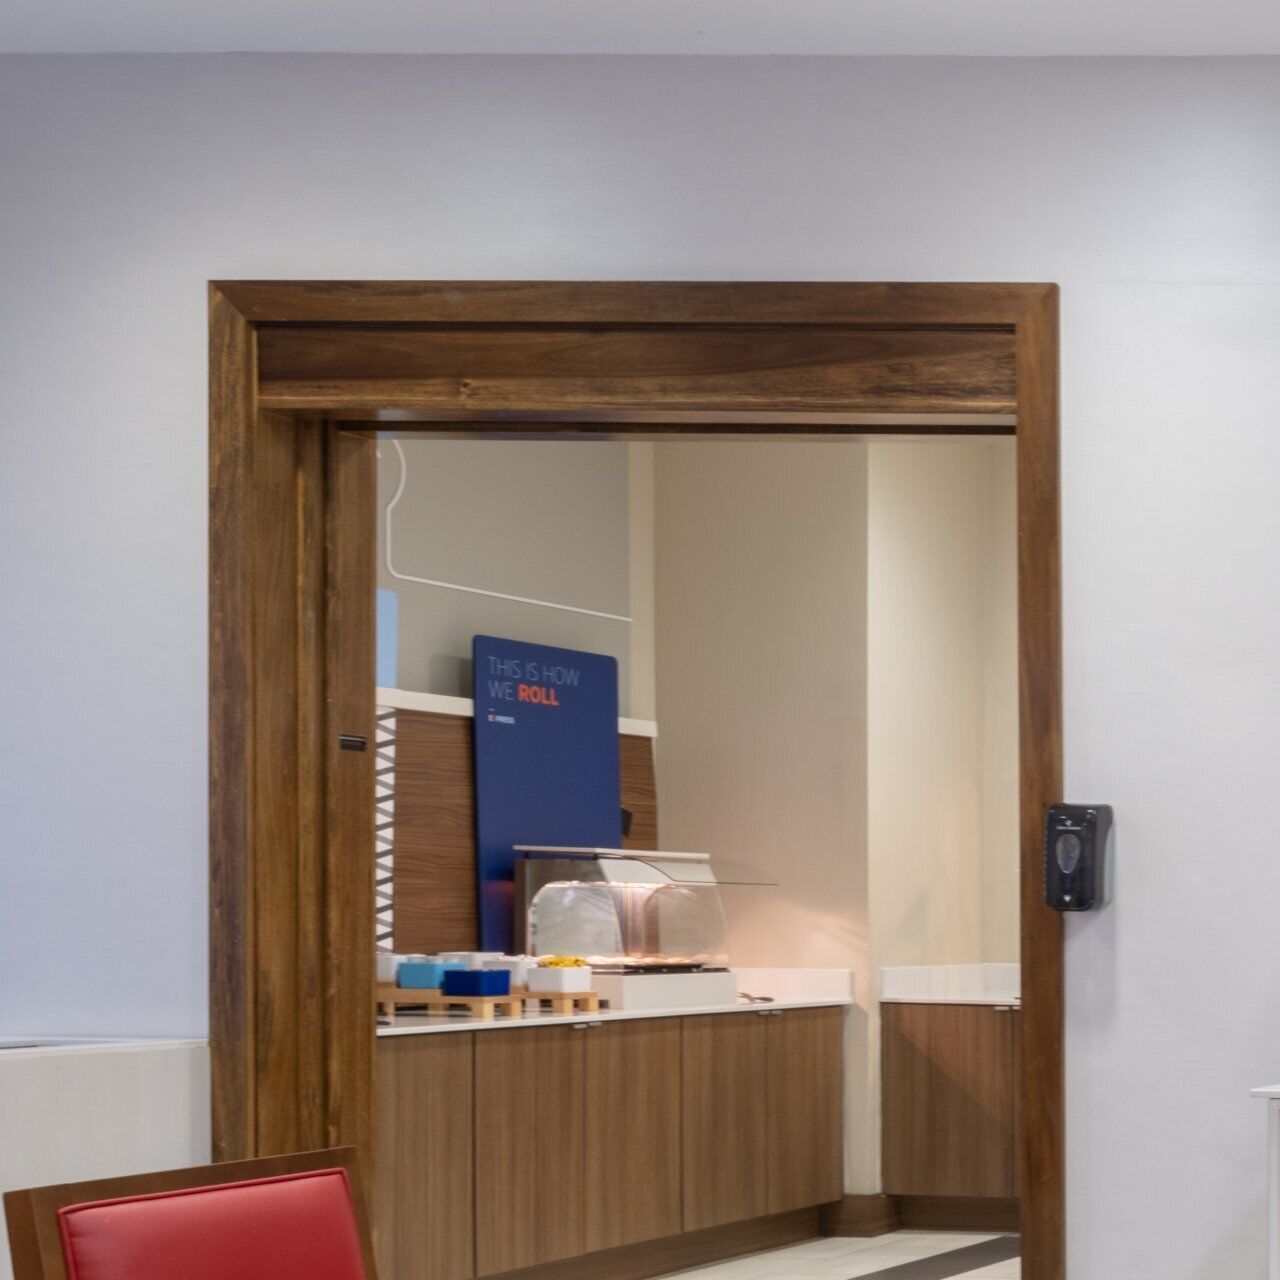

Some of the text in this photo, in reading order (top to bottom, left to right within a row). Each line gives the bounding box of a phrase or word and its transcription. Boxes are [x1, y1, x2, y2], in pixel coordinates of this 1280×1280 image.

[487, 656, 580, 686] THIS IS HOW
[487, 680, 560, 706] WE ROLL
